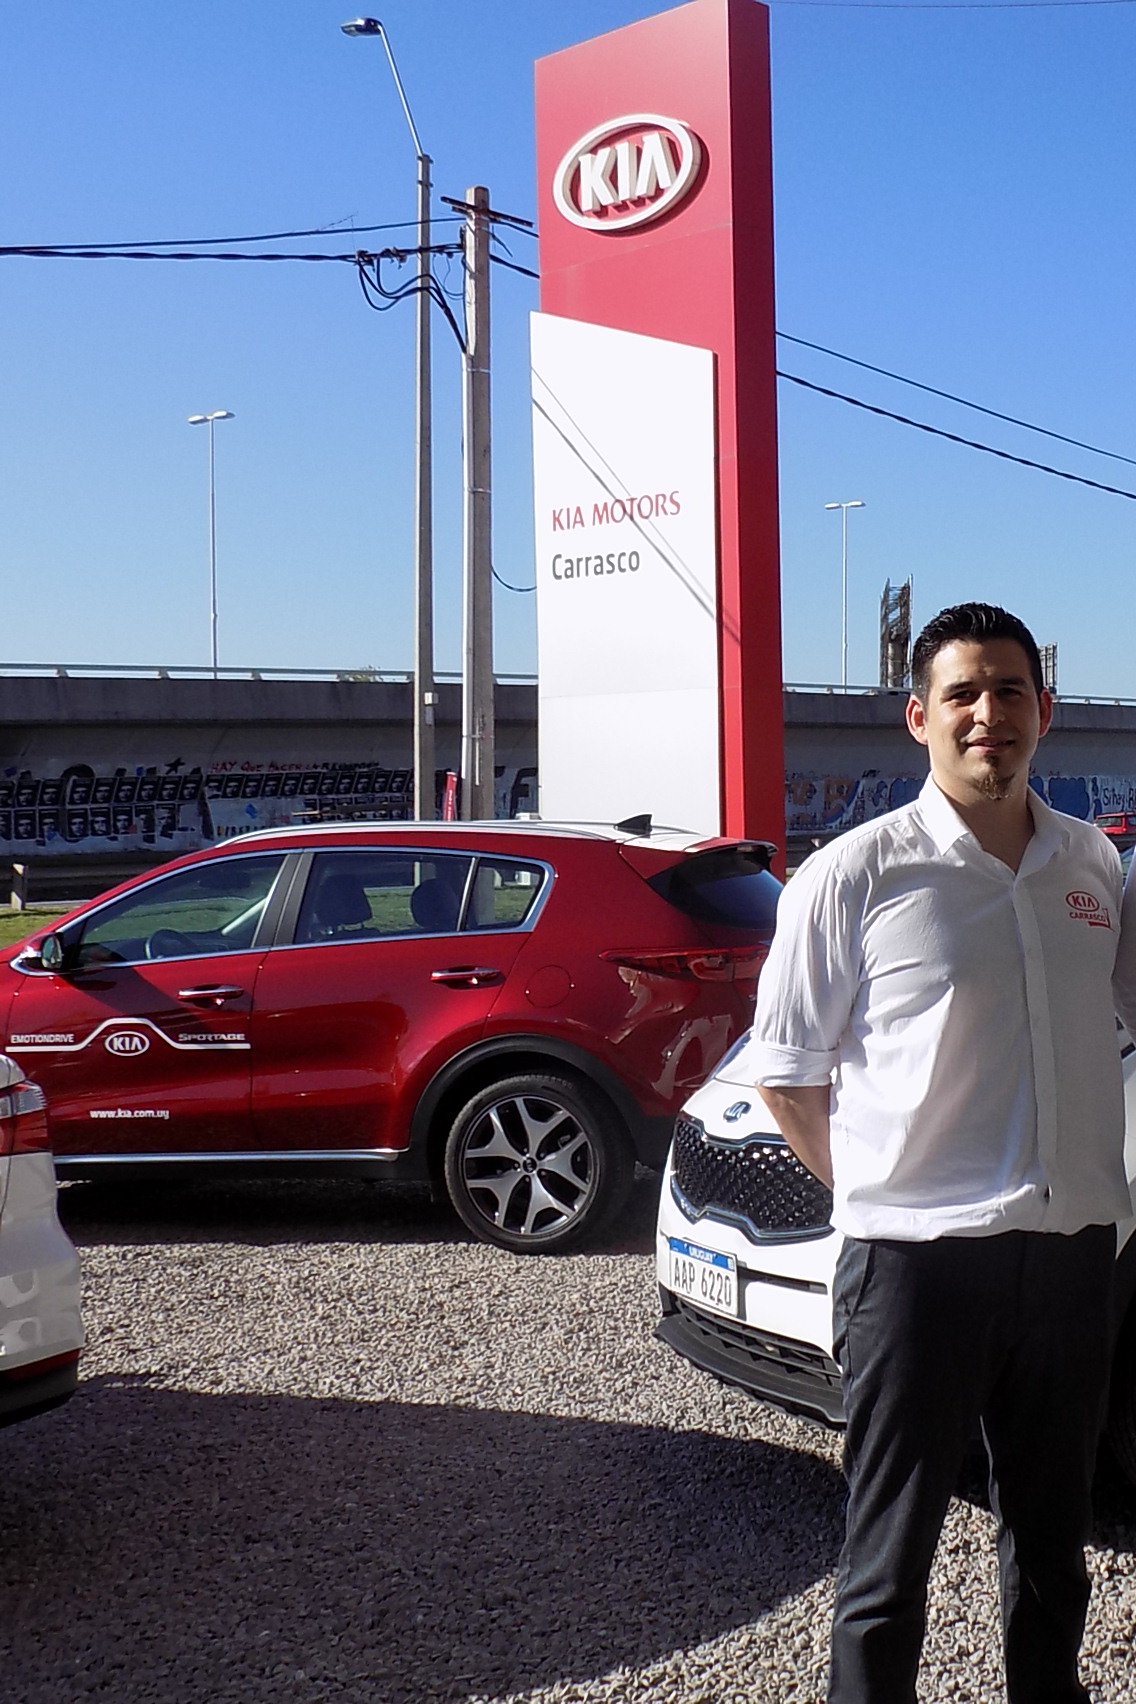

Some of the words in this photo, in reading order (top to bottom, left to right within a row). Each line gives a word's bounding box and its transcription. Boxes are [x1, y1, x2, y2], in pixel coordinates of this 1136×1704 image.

[578, 132, 677, 213] KIA
[552, 506, 585, 532] KIA
[592, 490, 681, 526] MOTORS
[552, 550, 640, 581] Carrasco
[1072, 894, 1096, 908] KIA
[112, 1037, 143, 1051] KIA
[178, 1033, 246, 1042] SPORTAGE
[90, 1108, 169, 1120] www.kia.com.uy
[674, 1257, 696, 1294] AAP
[701, 1267, 732, 1307] 6220
